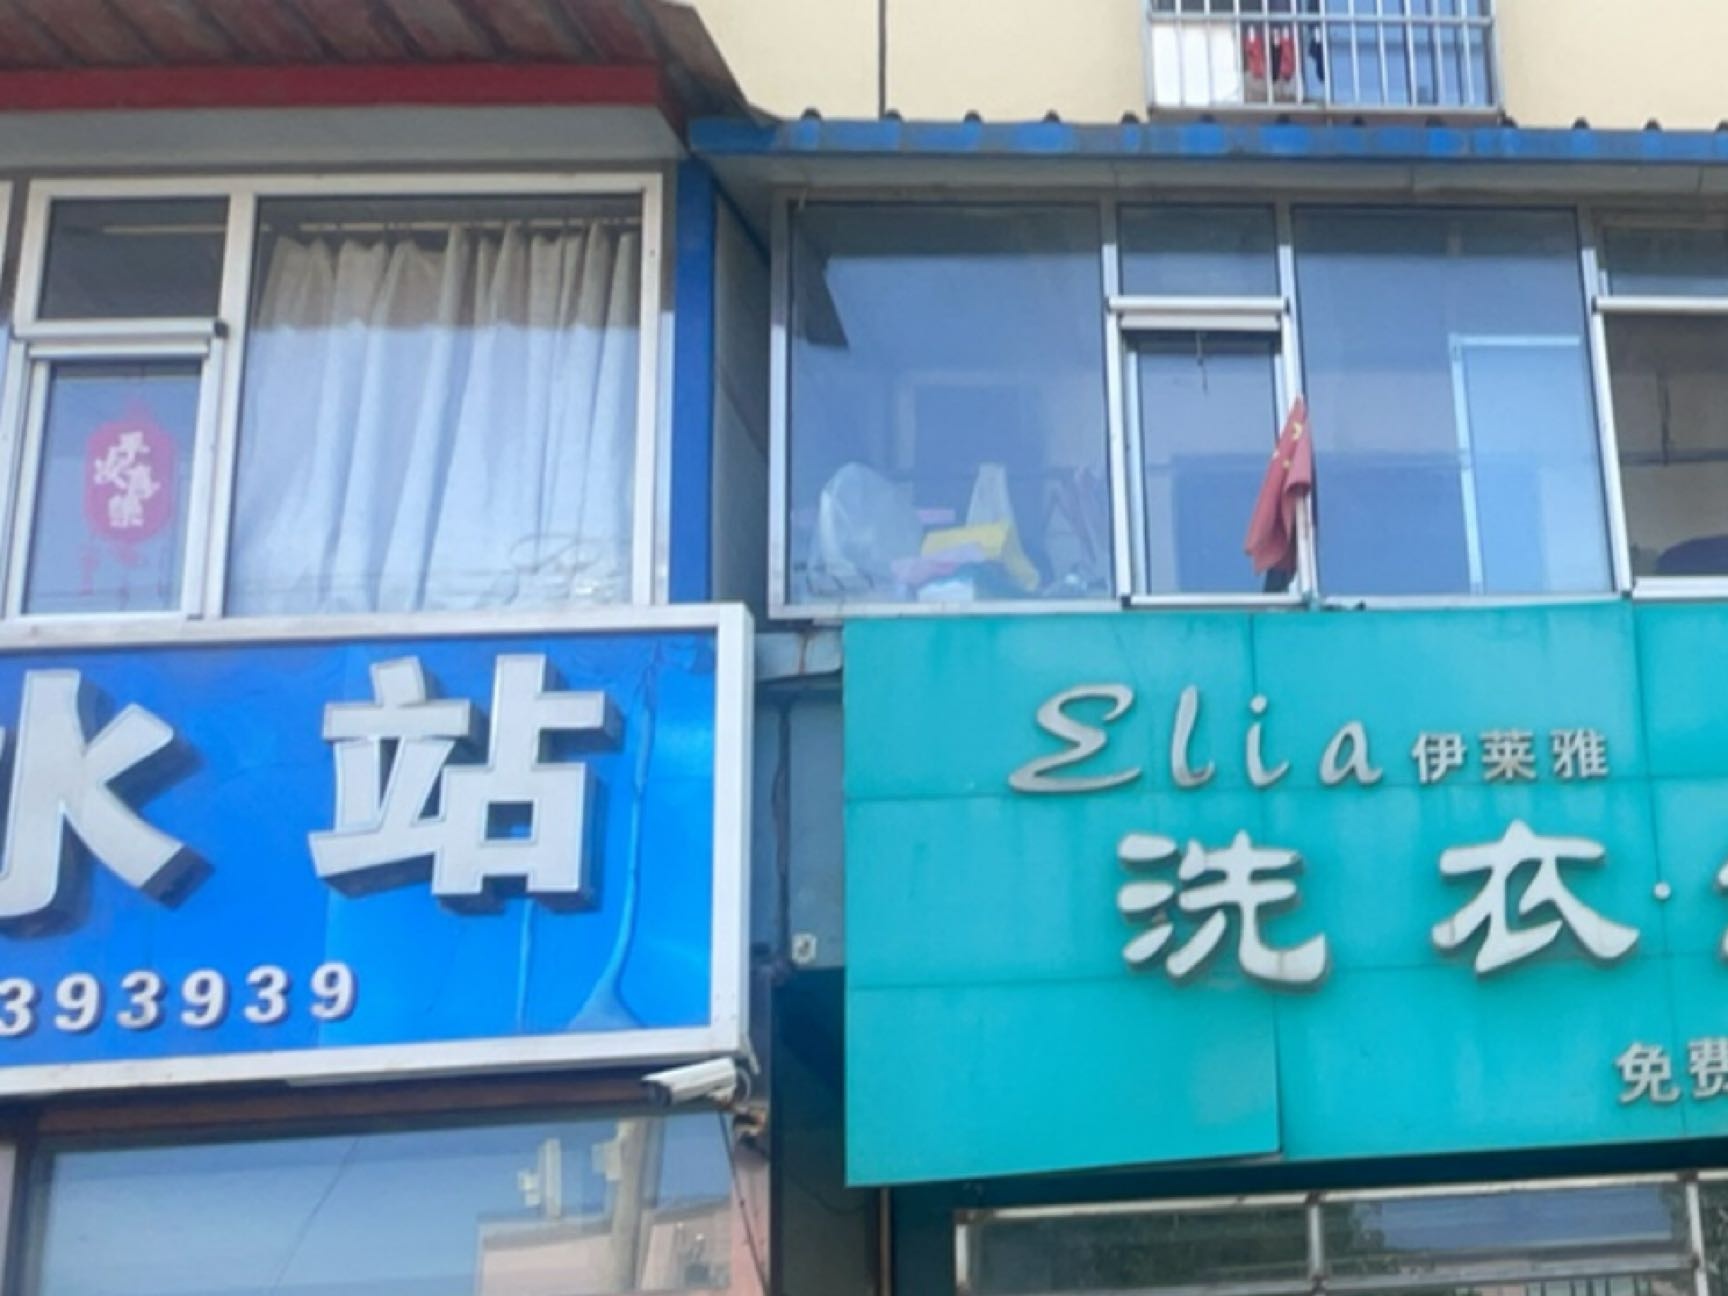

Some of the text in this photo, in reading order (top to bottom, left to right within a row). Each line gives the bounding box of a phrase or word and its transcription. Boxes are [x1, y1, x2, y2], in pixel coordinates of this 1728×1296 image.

[1009, 682, 1383, 792] Elia
[1411, 728, 1610, 783] 伊莱雅
[0, 653, 610, 918] 水站
[0, 962, 356, 1036] 393939
